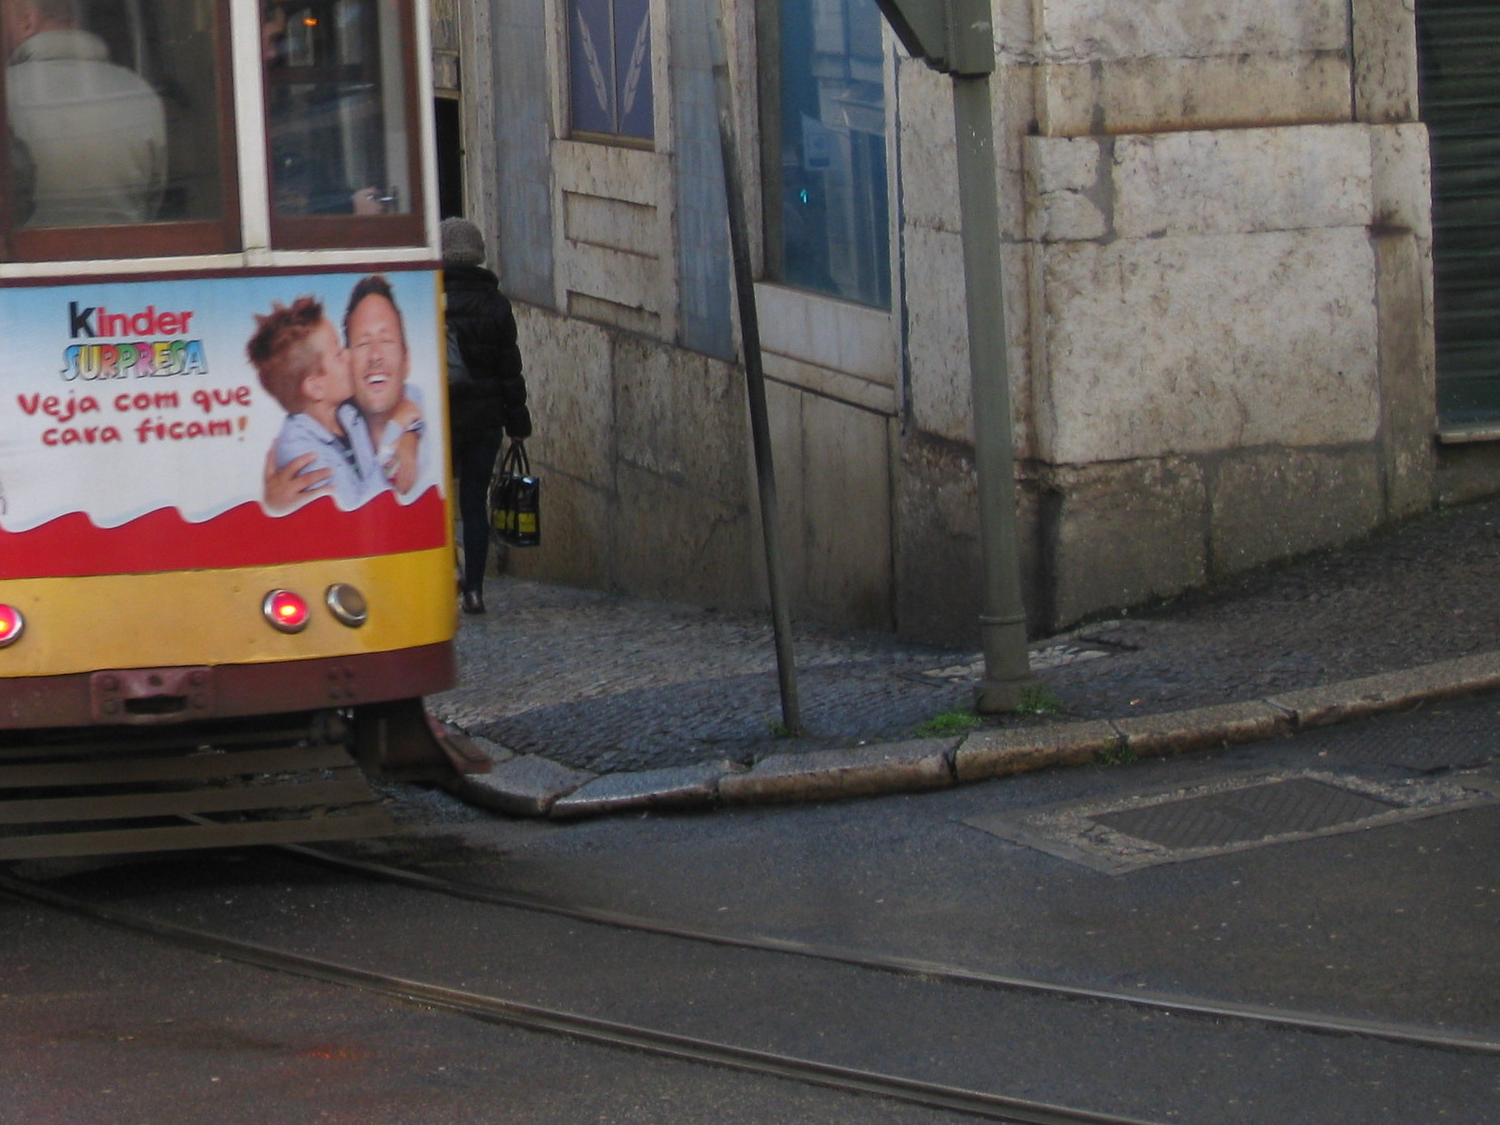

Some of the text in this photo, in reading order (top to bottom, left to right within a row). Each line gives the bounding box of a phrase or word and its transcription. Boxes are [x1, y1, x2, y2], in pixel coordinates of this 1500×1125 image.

[69, 301, 195, 339] Kinder
[61, 339, 208, 381] SURPRESA
[18, 386, 253, 423] Veja com que
[42, 416, 249, 447] cara ficam!
